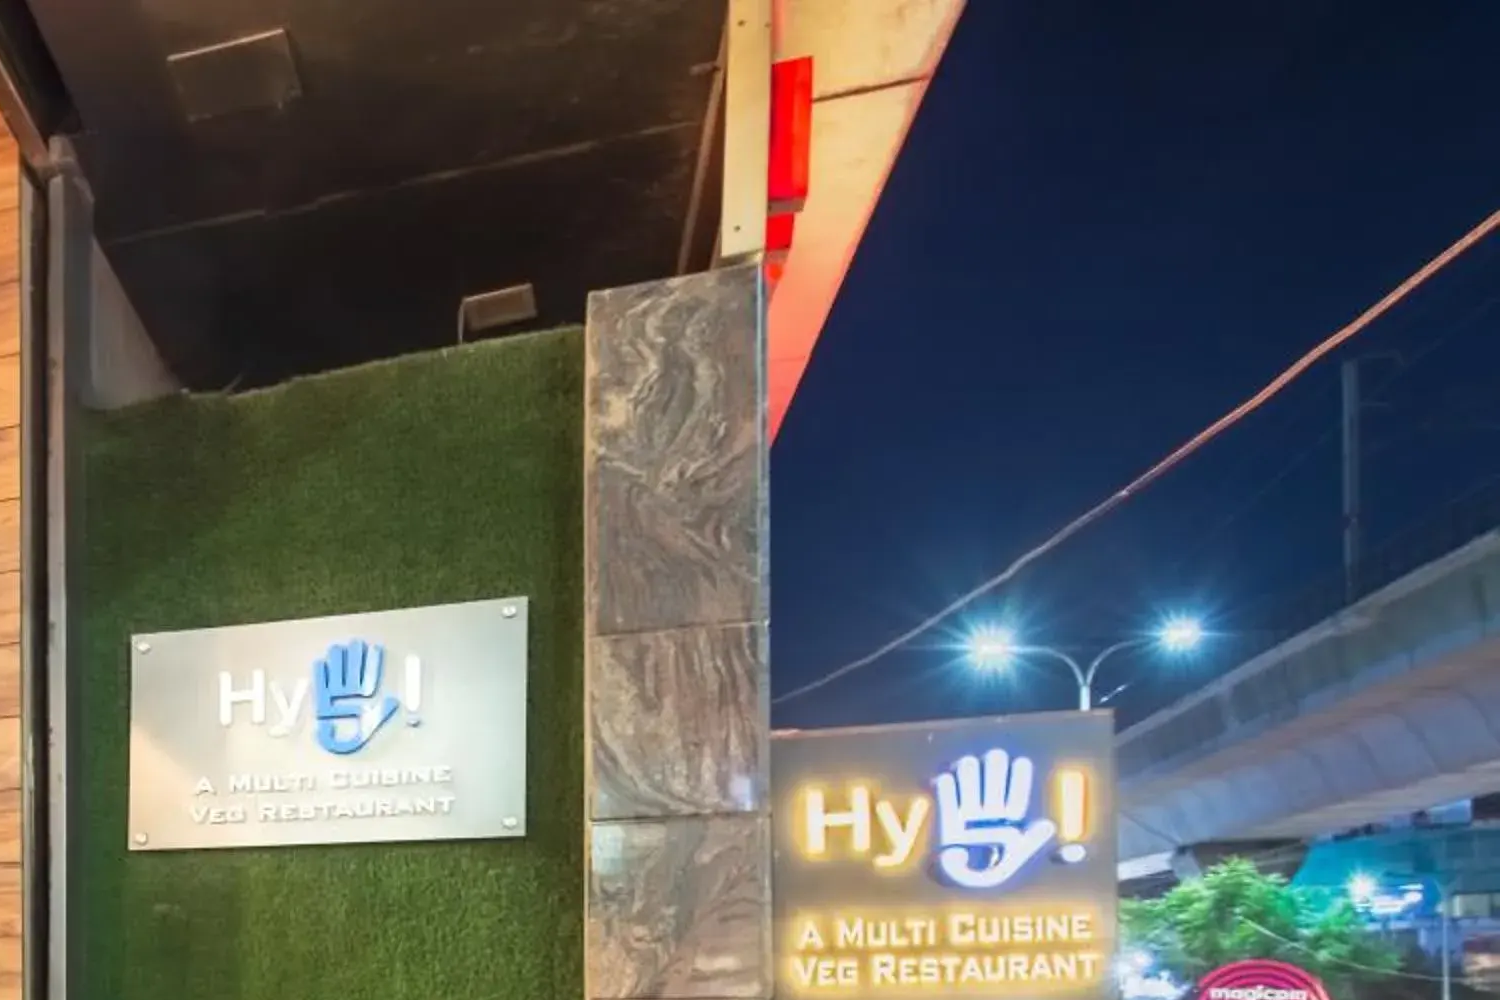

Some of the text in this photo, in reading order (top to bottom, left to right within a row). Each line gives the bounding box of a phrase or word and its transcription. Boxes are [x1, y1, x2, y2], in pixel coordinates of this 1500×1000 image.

[194, 775, 217, 797] A
[229, 773, 318, 795] MULTI
[189, 796, 456, 826] VEG RESTAURANT
[799, 912, 1093, 949] A MULTI CUISINE
[791, 951, 1105, 987] VEG RESTAURANT
